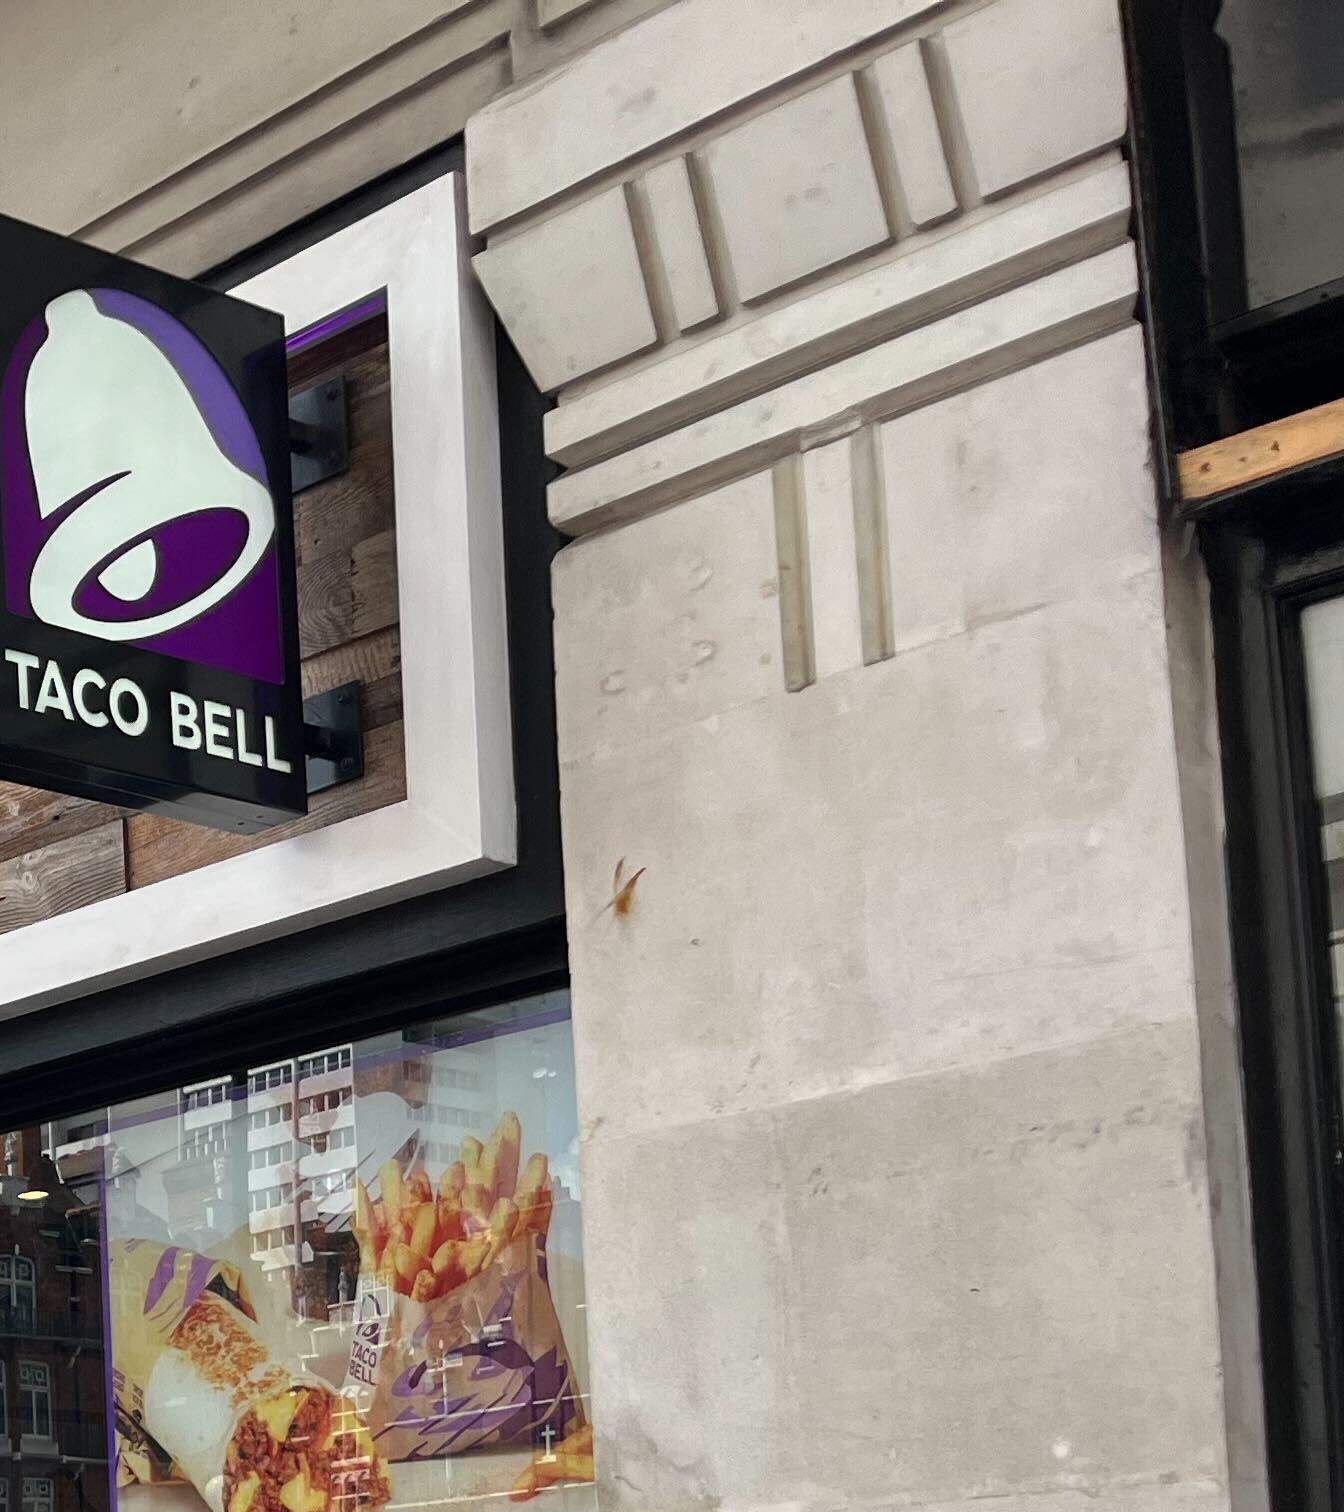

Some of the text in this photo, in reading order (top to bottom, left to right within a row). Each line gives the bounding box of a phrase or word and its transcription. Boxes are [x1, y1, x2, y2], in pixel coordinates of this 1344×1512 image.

[5, 649, 291, 773] TACO BELL
[352, 1341, 377, 1368] TACO
[349, 1360, 379, 1386] BELL
